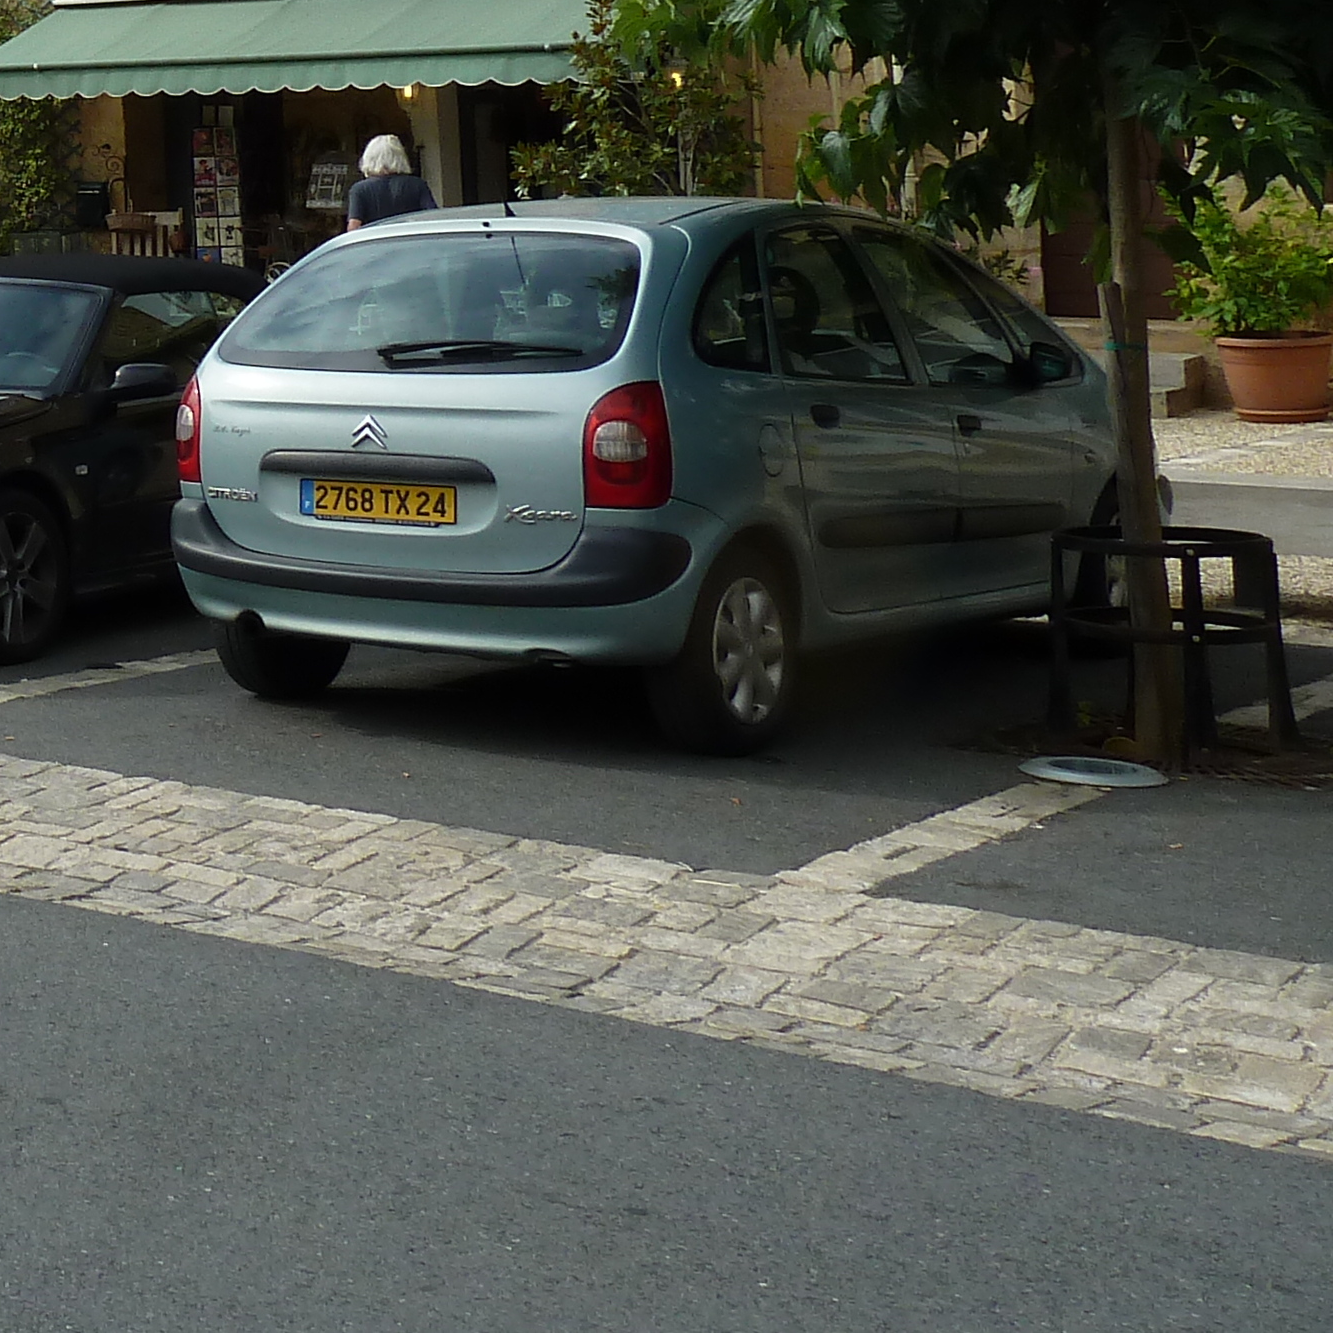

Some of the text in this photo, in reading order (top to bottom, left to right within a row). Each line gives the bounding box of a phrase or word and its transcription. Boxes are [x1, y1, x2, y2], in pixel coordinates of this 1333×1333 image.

[315, 484, 375, 513] 2768
[382, 489, 411, 516] TX
[416, 491, 447, 518] 24
